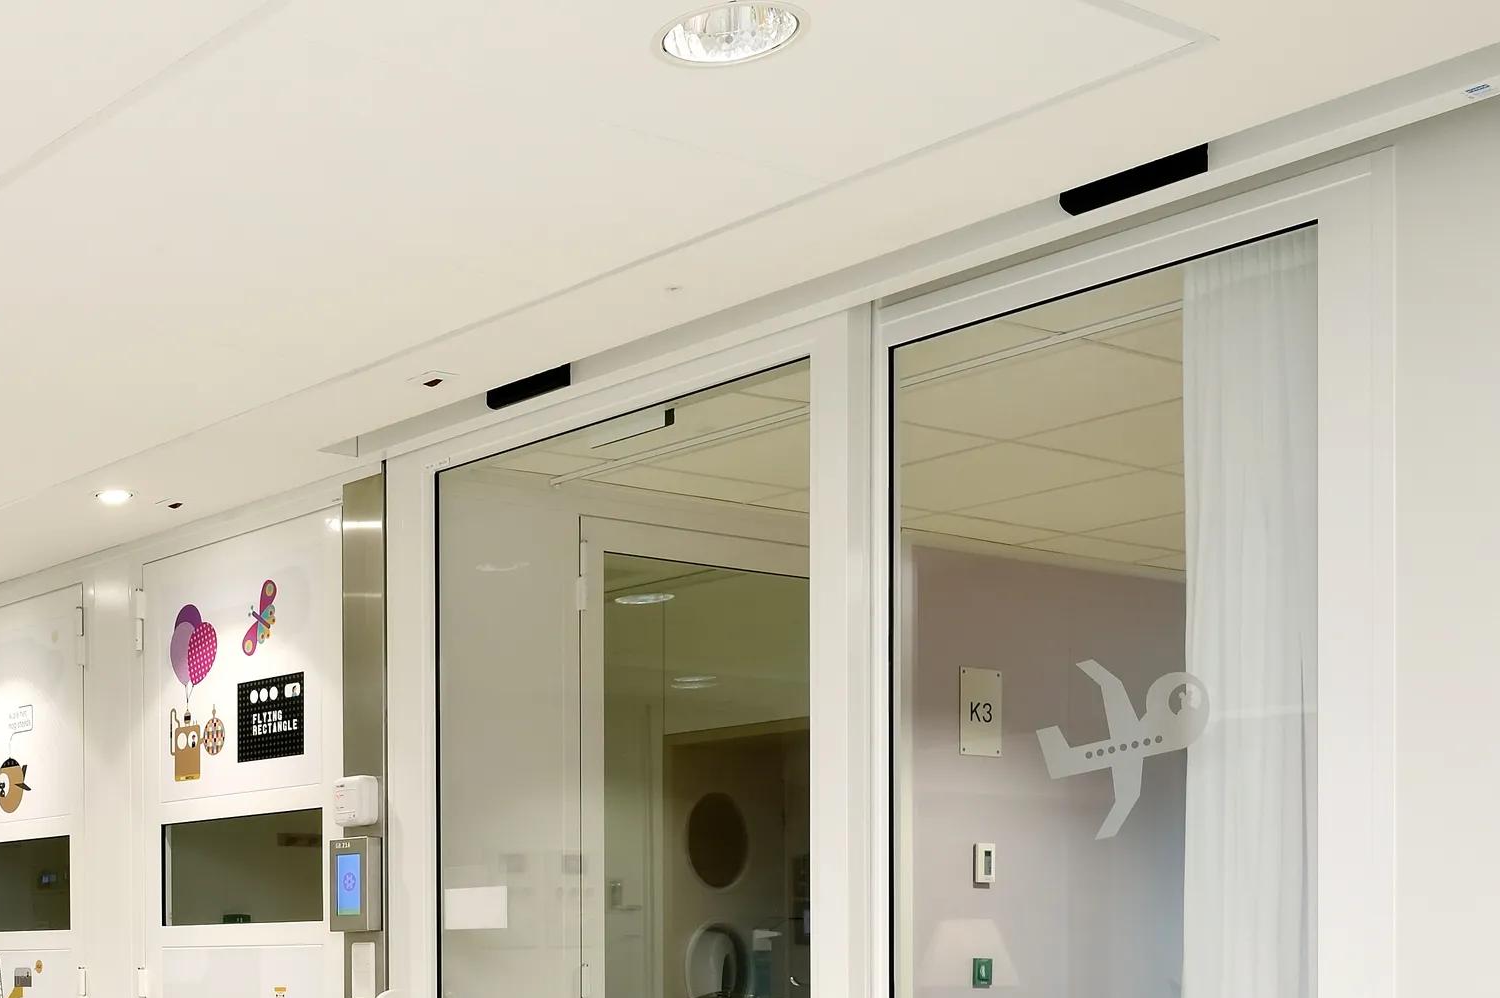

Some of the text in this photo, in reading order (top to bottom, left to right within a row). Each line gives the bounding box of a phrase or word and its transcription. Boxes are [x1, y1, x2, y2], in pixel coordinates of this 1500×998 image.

[252, 709, 283, 725] FLYING
[969, 701, 993, 723] K3
[252, 718, 298, 736] RECTANGLE
